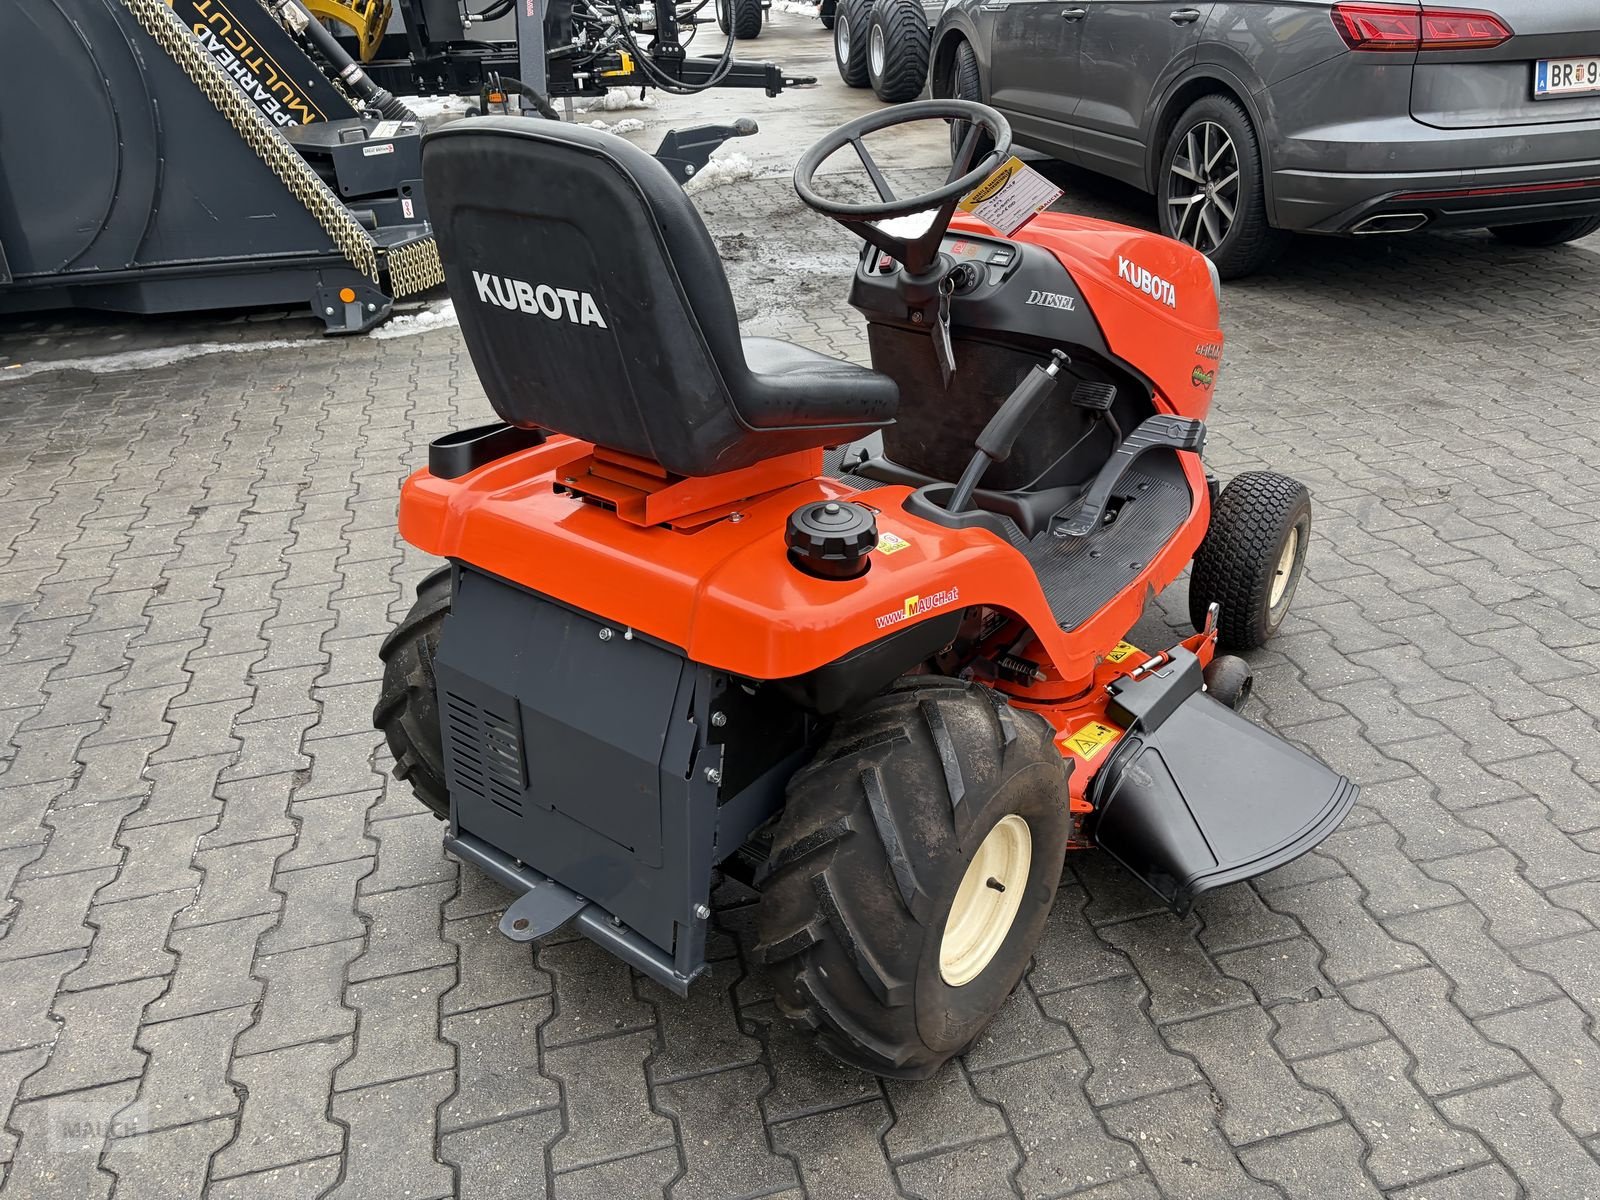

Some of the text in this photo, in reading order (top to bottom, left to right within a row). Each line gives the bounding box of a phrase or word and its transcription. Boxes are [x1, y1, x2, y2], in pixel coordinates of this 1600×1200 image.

[192, 0, 316, 126] MULTICUT
[193, 23, 299, 127] SPEARHEAD
[1552, 61, 1600, 87] BR 9
[472, 270, 608, 329] KUBOTA
[1025, 290, 1076, 312] DIESEL
[1118, 255, 1176, 309] KUBOTA
[876, 588, 958, 628] www.MAUCH.at
